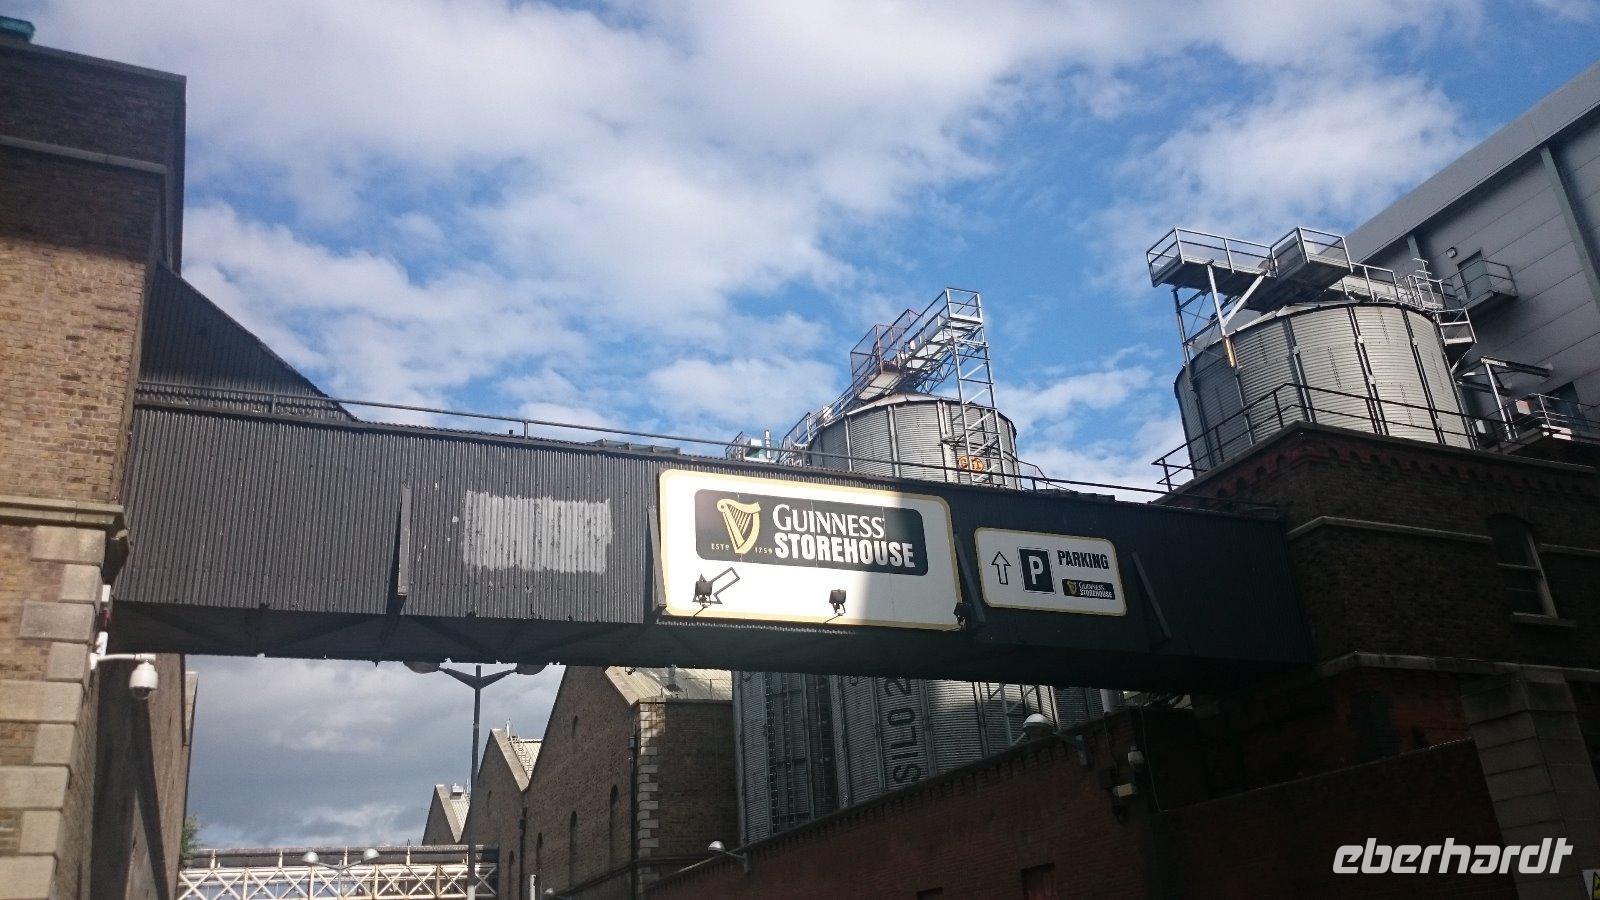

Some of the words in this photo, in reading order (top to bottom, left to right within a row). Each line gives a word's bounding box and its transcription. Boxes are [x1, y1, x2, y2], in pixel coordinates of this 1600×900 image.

[772, 504, 885, 539] GUINNESS
[773, 532, 916, 569] STOREHOUSE
[1057, 550, 1110, 570] PARKING
[1028, 555, 1044, 585] P
[887, 707, 921, 783] SILO
